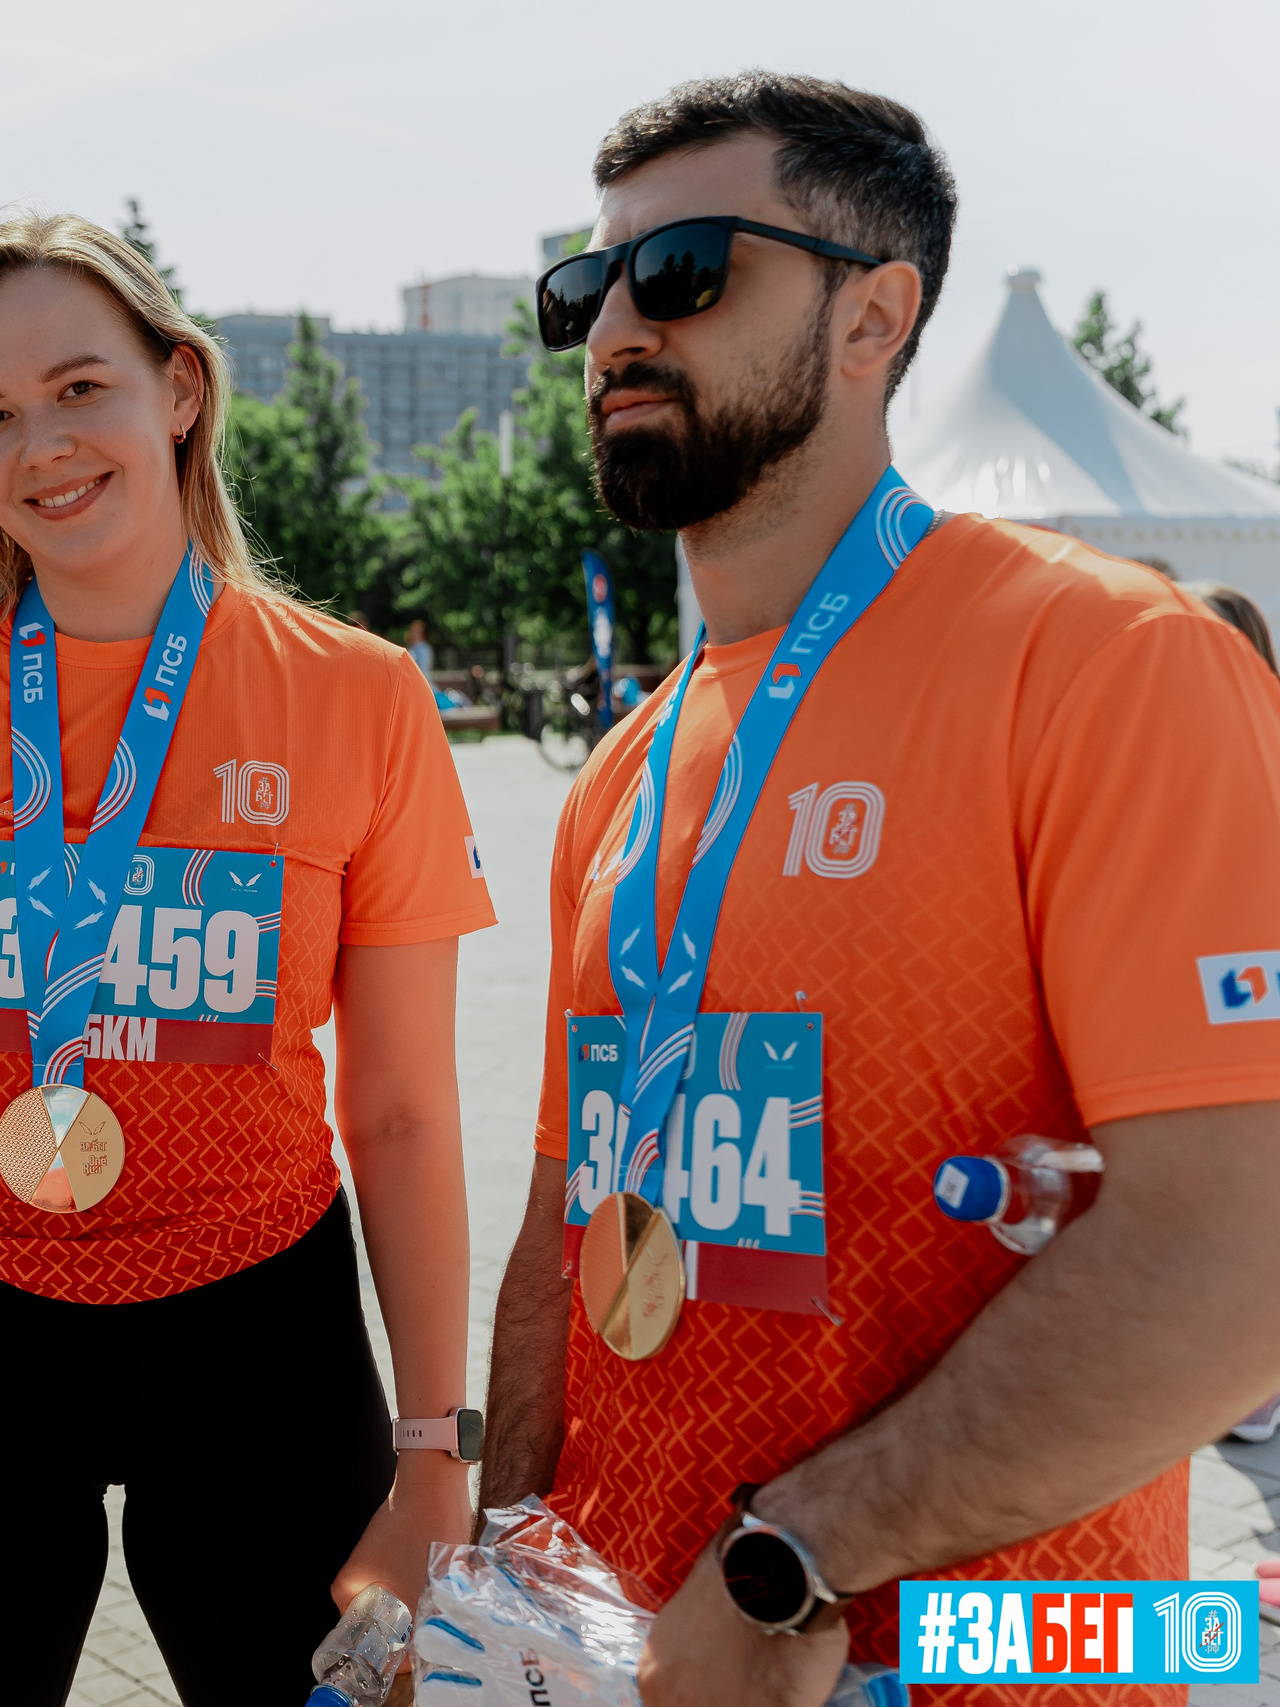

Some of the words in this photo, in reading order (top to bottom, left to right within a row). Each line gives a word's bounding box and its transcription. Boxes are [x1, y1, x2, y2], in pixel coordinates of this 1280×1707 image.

[790, 592, 849, 654] ПСБ
[23, 653, 43, 704] ПСБ
[154, 633, 187, 687] ПСБ
[212, 758, 290, 826] 10
[782, 781, 886, 879] 10
[590, 1044, 618, 1062] ПСБ
